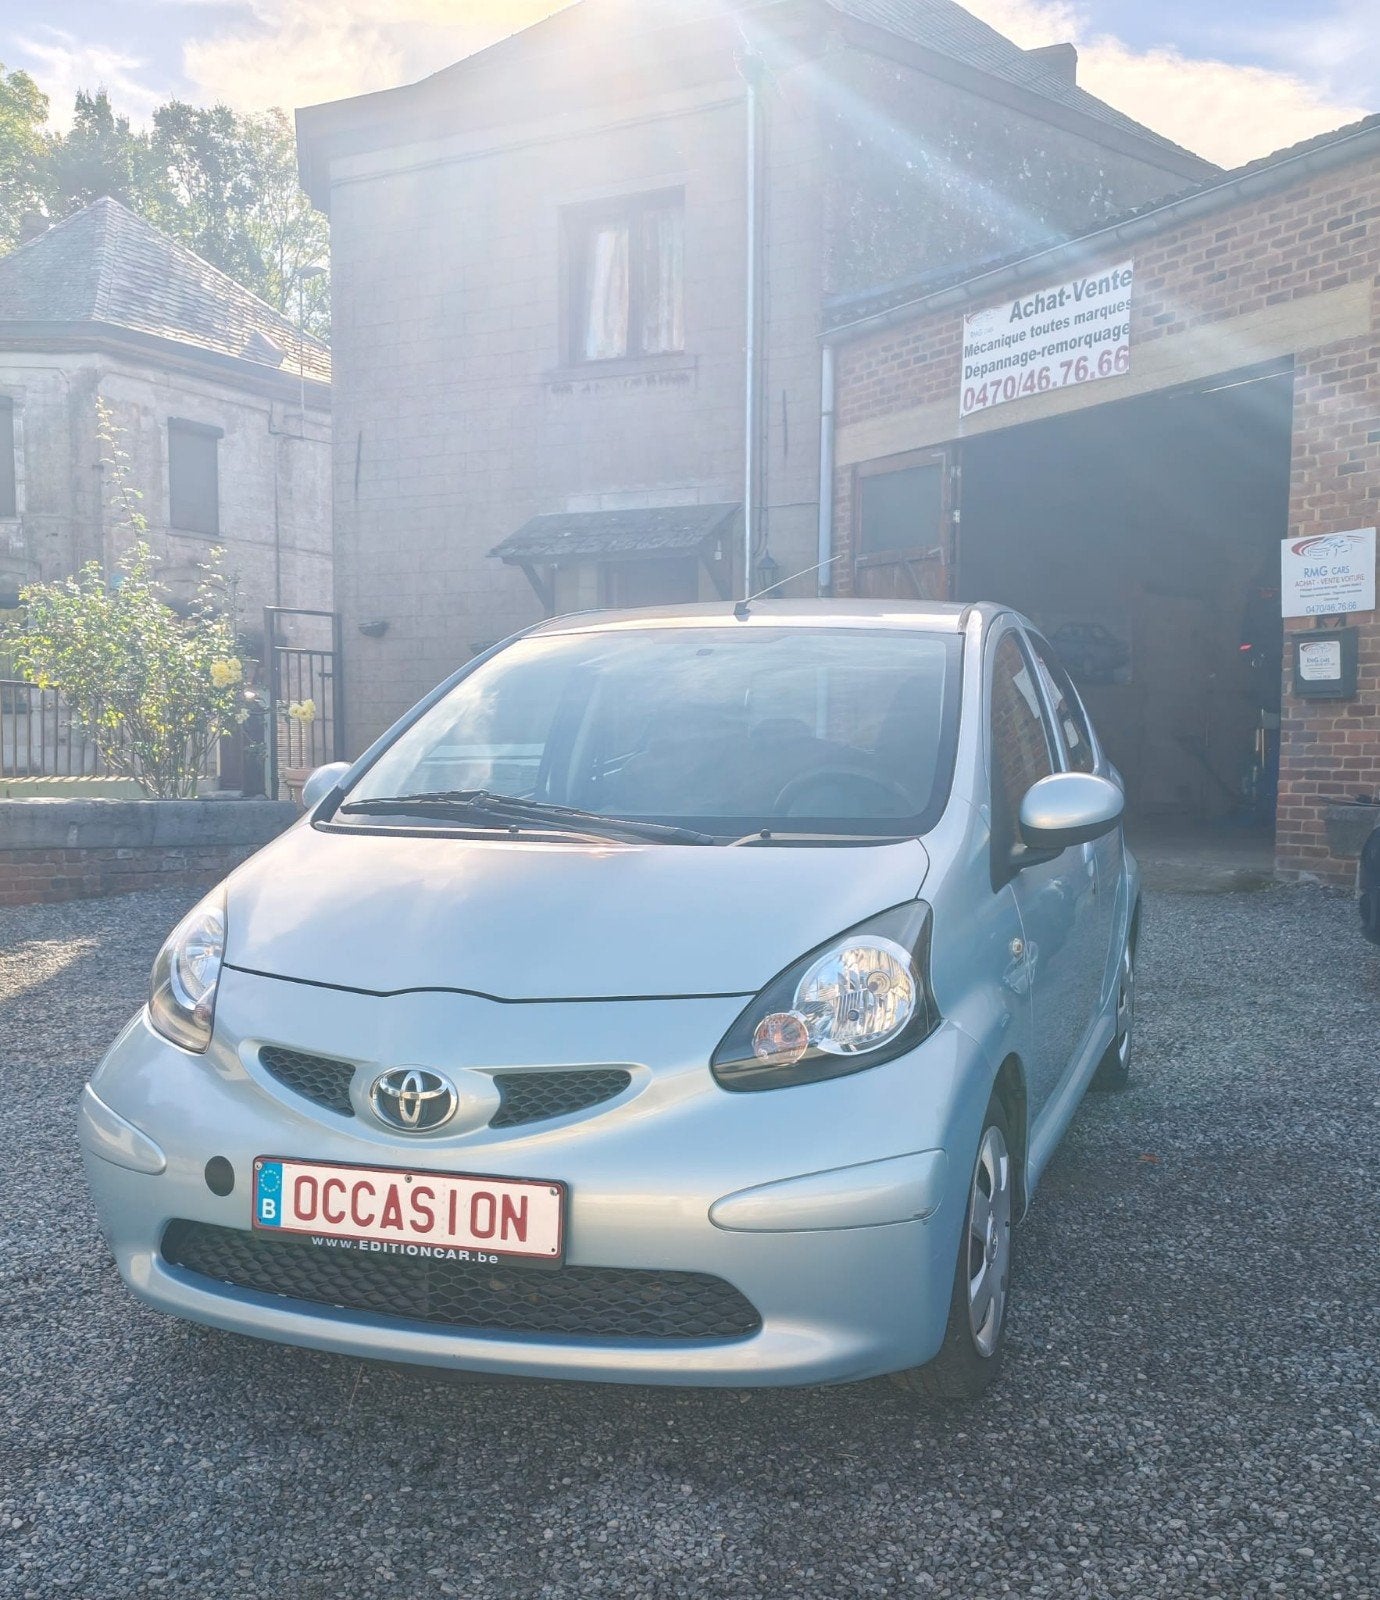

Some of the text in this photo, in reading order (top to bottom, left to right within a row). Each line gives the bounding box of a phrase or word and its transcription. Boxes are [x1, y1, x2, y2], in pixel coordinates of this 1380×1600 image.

[1009, 269, 1133, 323] Achat-Vente
[964, 298, 1132, 359] Mécanique toutes marques
[964, 322, 1130, 380] Dépannage-remorquage
[963, 345, 1130, 412] 0470/46.76.66
[1295, 579, 1316, 588] ACHAT
[1320, 576, 1341, 585] VENTE
[1304, 565, 1350, 578] RMG CARS
[261, 1174, 529, 1243] B OCCASION
[311, 1236, 499, 1264] www.EDITIONCAR.be
